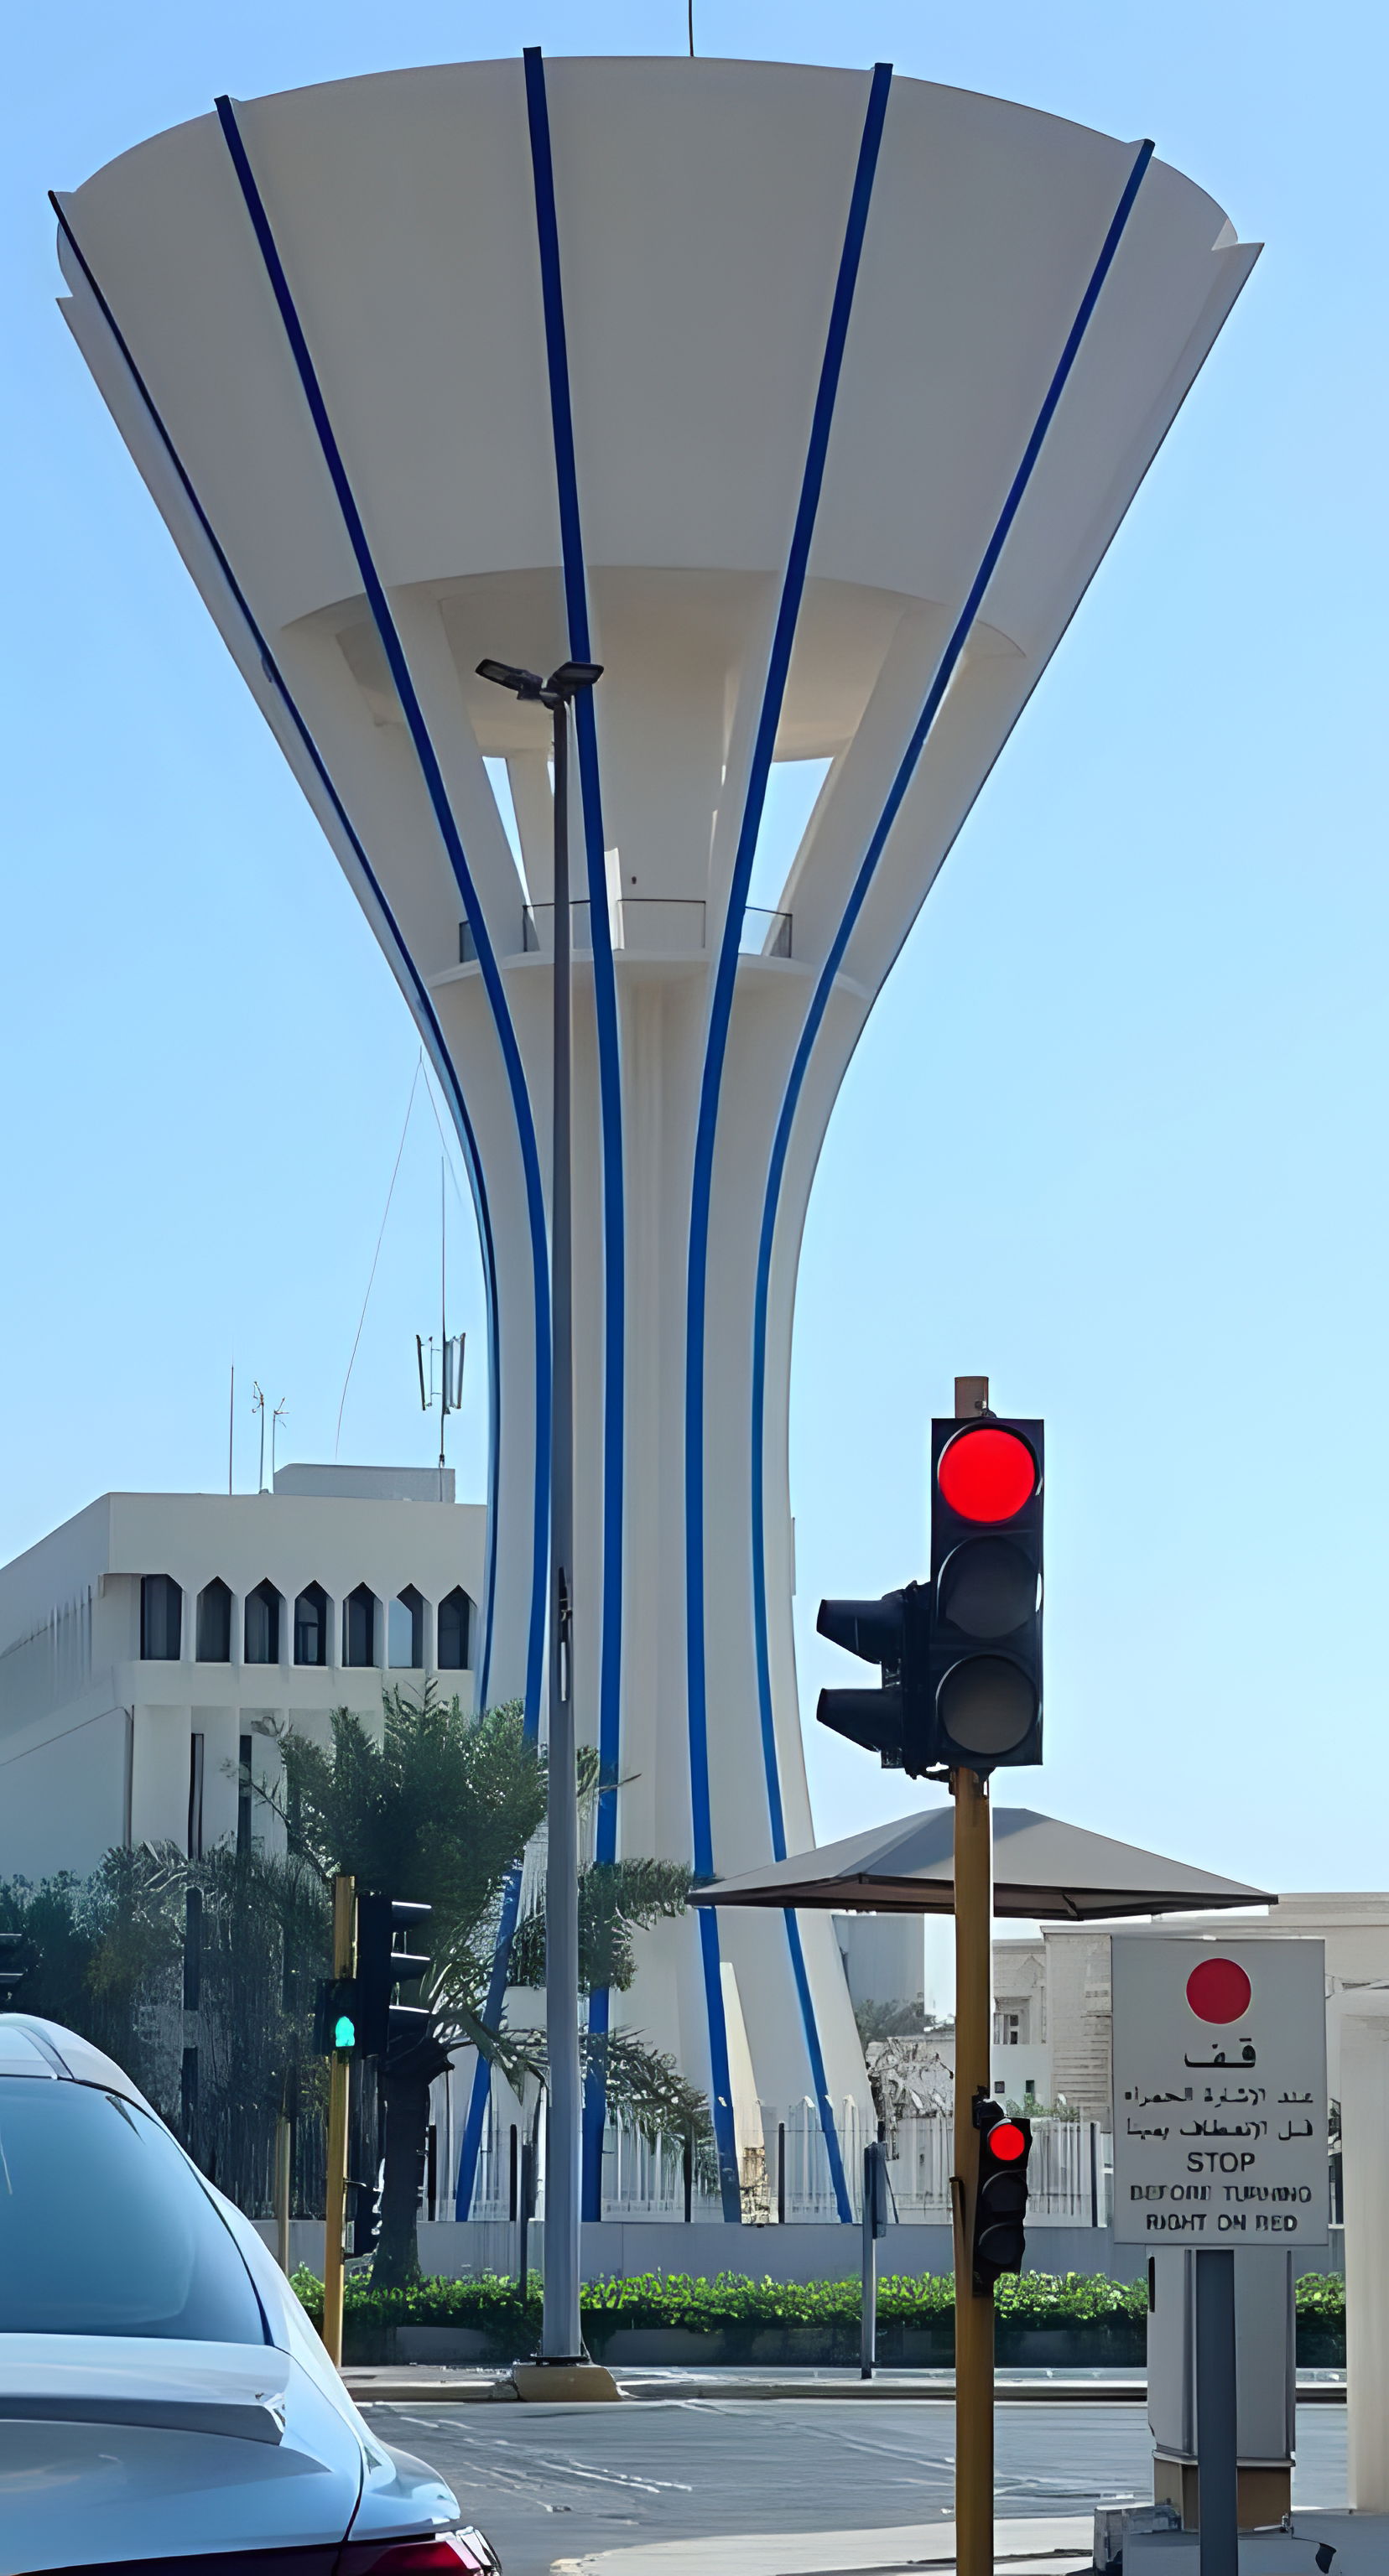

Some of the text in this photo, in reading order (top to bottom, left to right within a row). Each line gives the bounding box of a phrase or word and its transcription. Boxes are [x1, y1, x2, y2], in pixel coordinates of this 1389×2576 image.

[1184, 2038, 1256, 2068] قف
[1187, 2152, 1256, 2173] STOP
[1147, 2214, 1298, 2231] RIGHT ON RED
